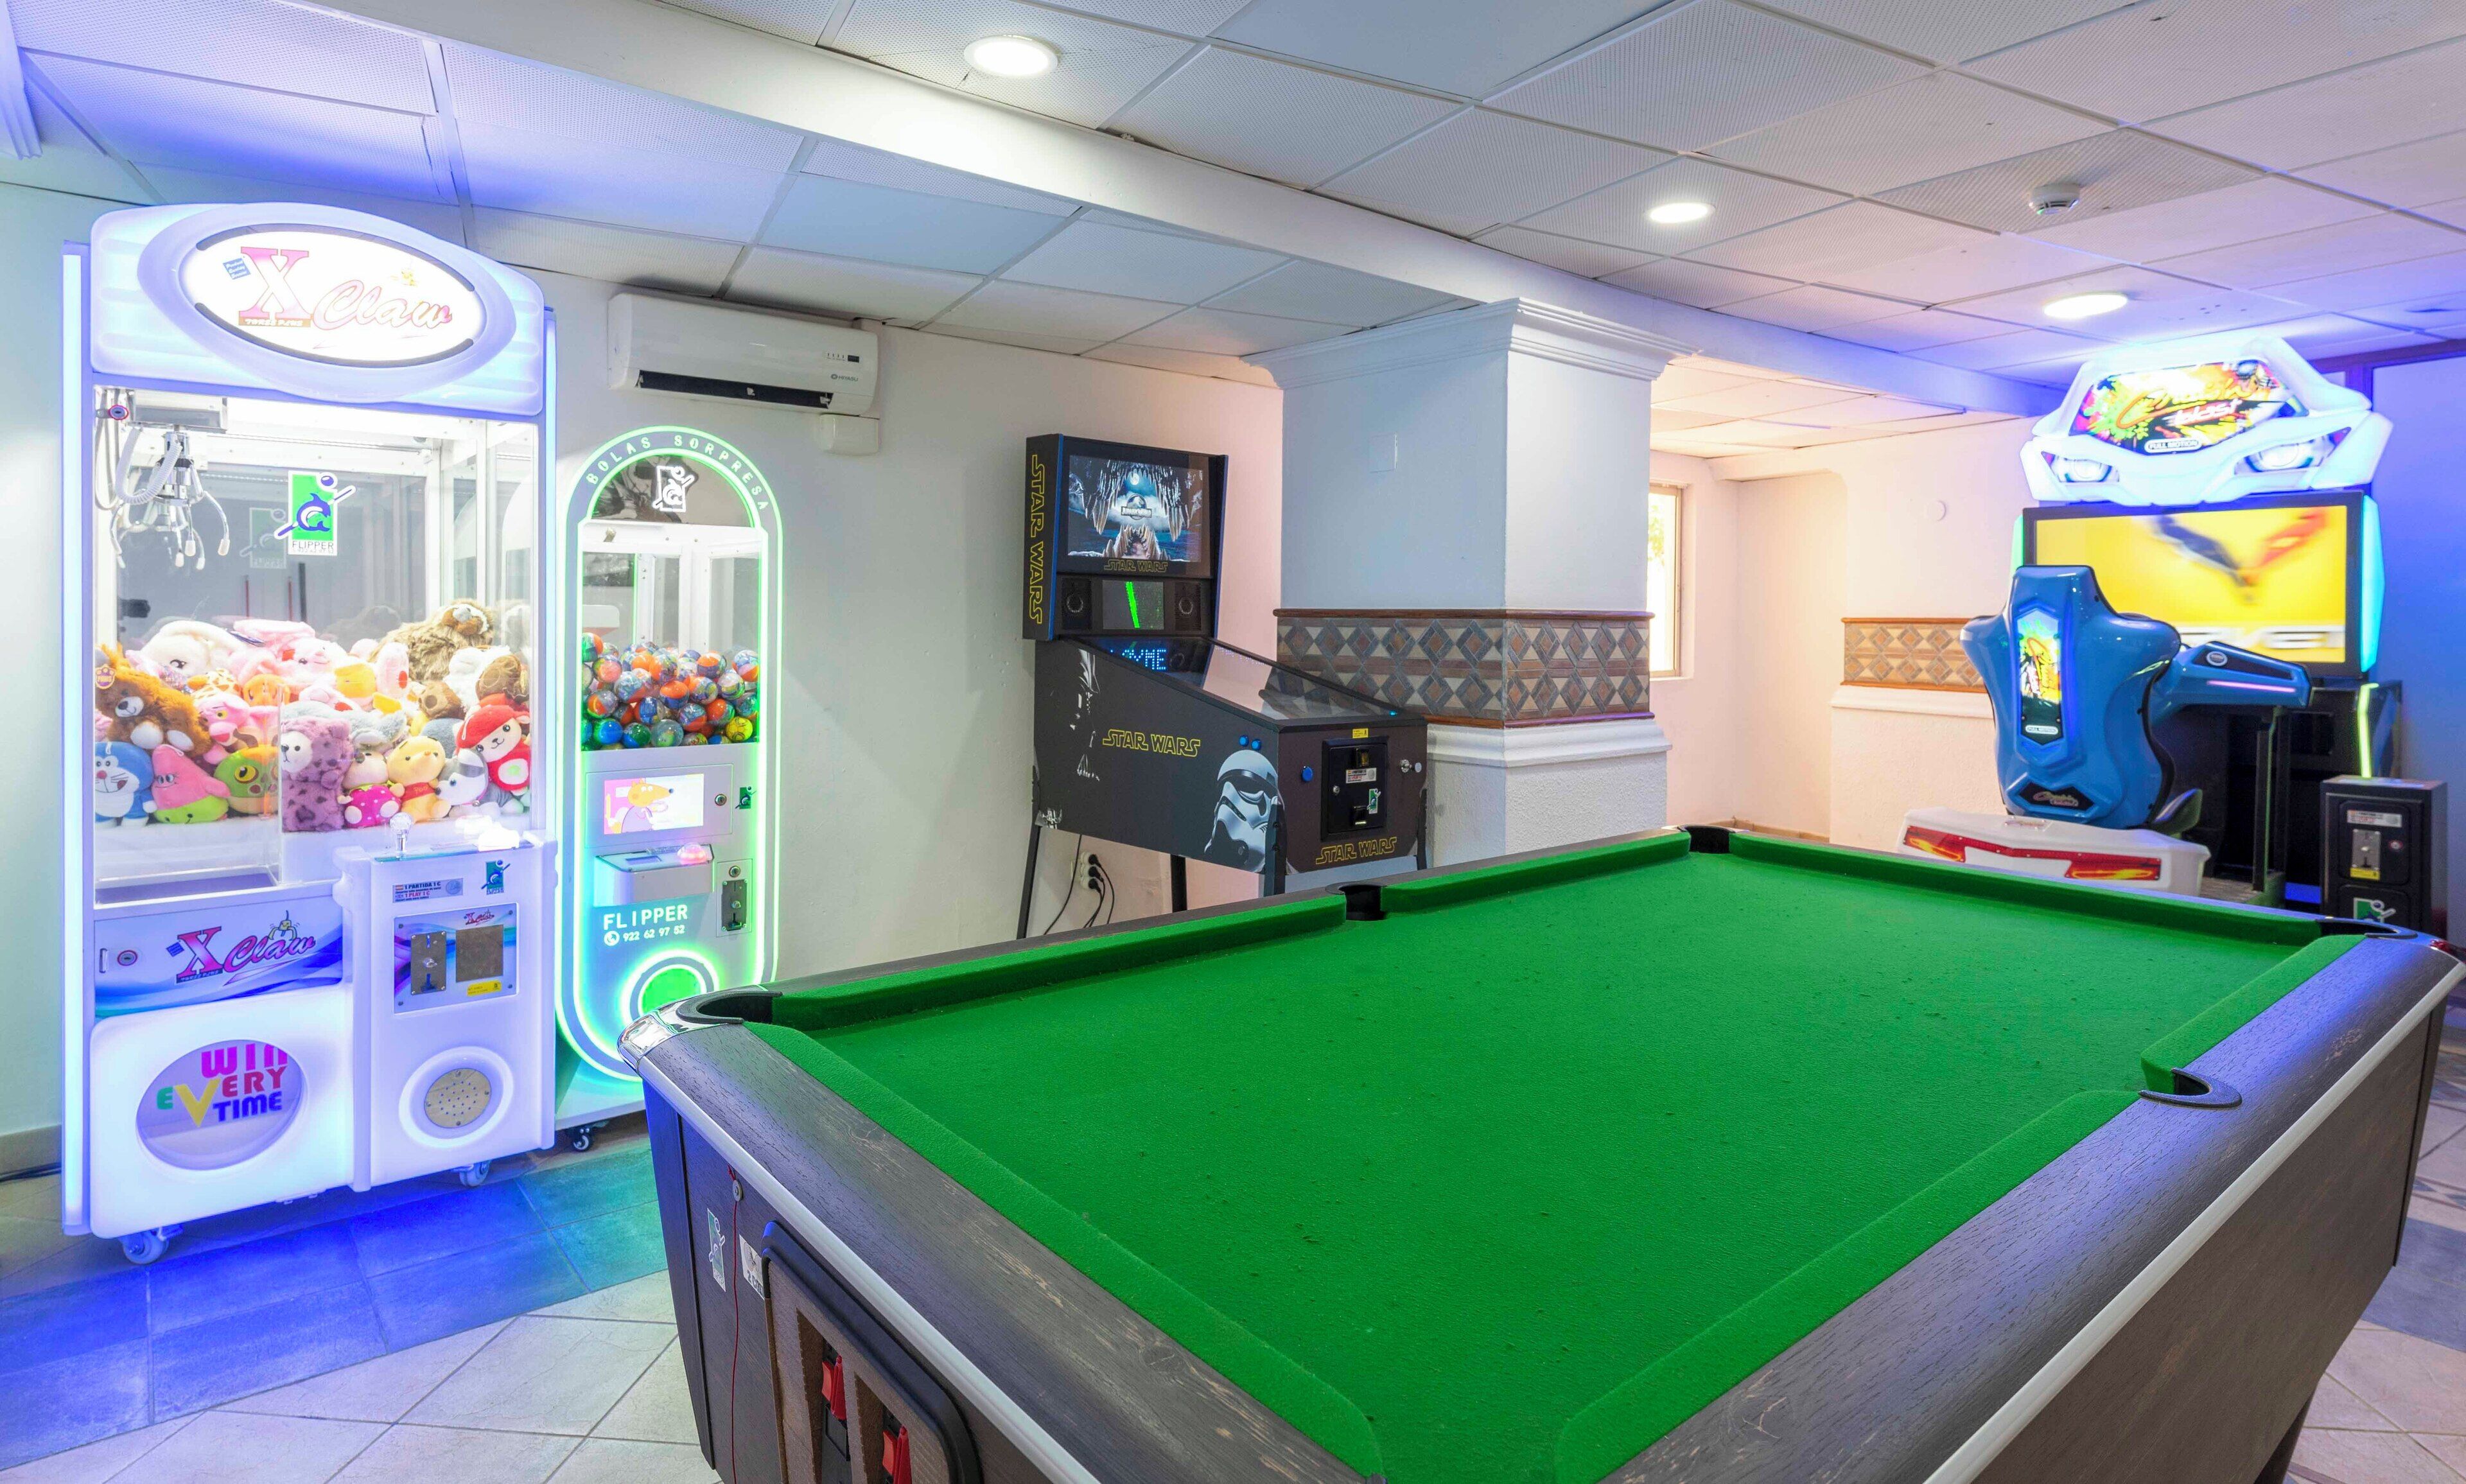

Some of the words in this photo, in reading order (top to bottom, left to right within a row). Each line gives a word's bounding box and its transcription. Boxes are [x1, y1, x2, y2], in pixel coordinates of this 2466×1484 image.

[240, 247, 310, 320] X
[311, 279, 453, 330] Claw
[585, 436, 651, 485] BOLAS
[674, 434, 769, 511] SORPRESA
[1031, 454, 1045, 538] STAR
[292, 541, 334, 550] FLIPPER
[1104, 559, 1137, 572] STAR
[1137, 560, 1169, 573] WARS
[1029, 541, 1044, 625] WARS
[1102, 729, 1149, 751] STAR
[1150, 734, 1201, 758] WARS
[1315, 842, 1358, 865] STAR
[1358, 836, 1397, 857] WARS
[603, 904, 688, 930] FLIPPER
[623, 930, 640, 942] 922
[643, 929, 655, 939] 62
[658, 927, 670, 937] 97
[176, 925, 223, 979] X
[223, 935, 316, 972] Claw
[156, 1066, 287, 1128] EVERY
[213, 1091, 283, 1122] TIME
